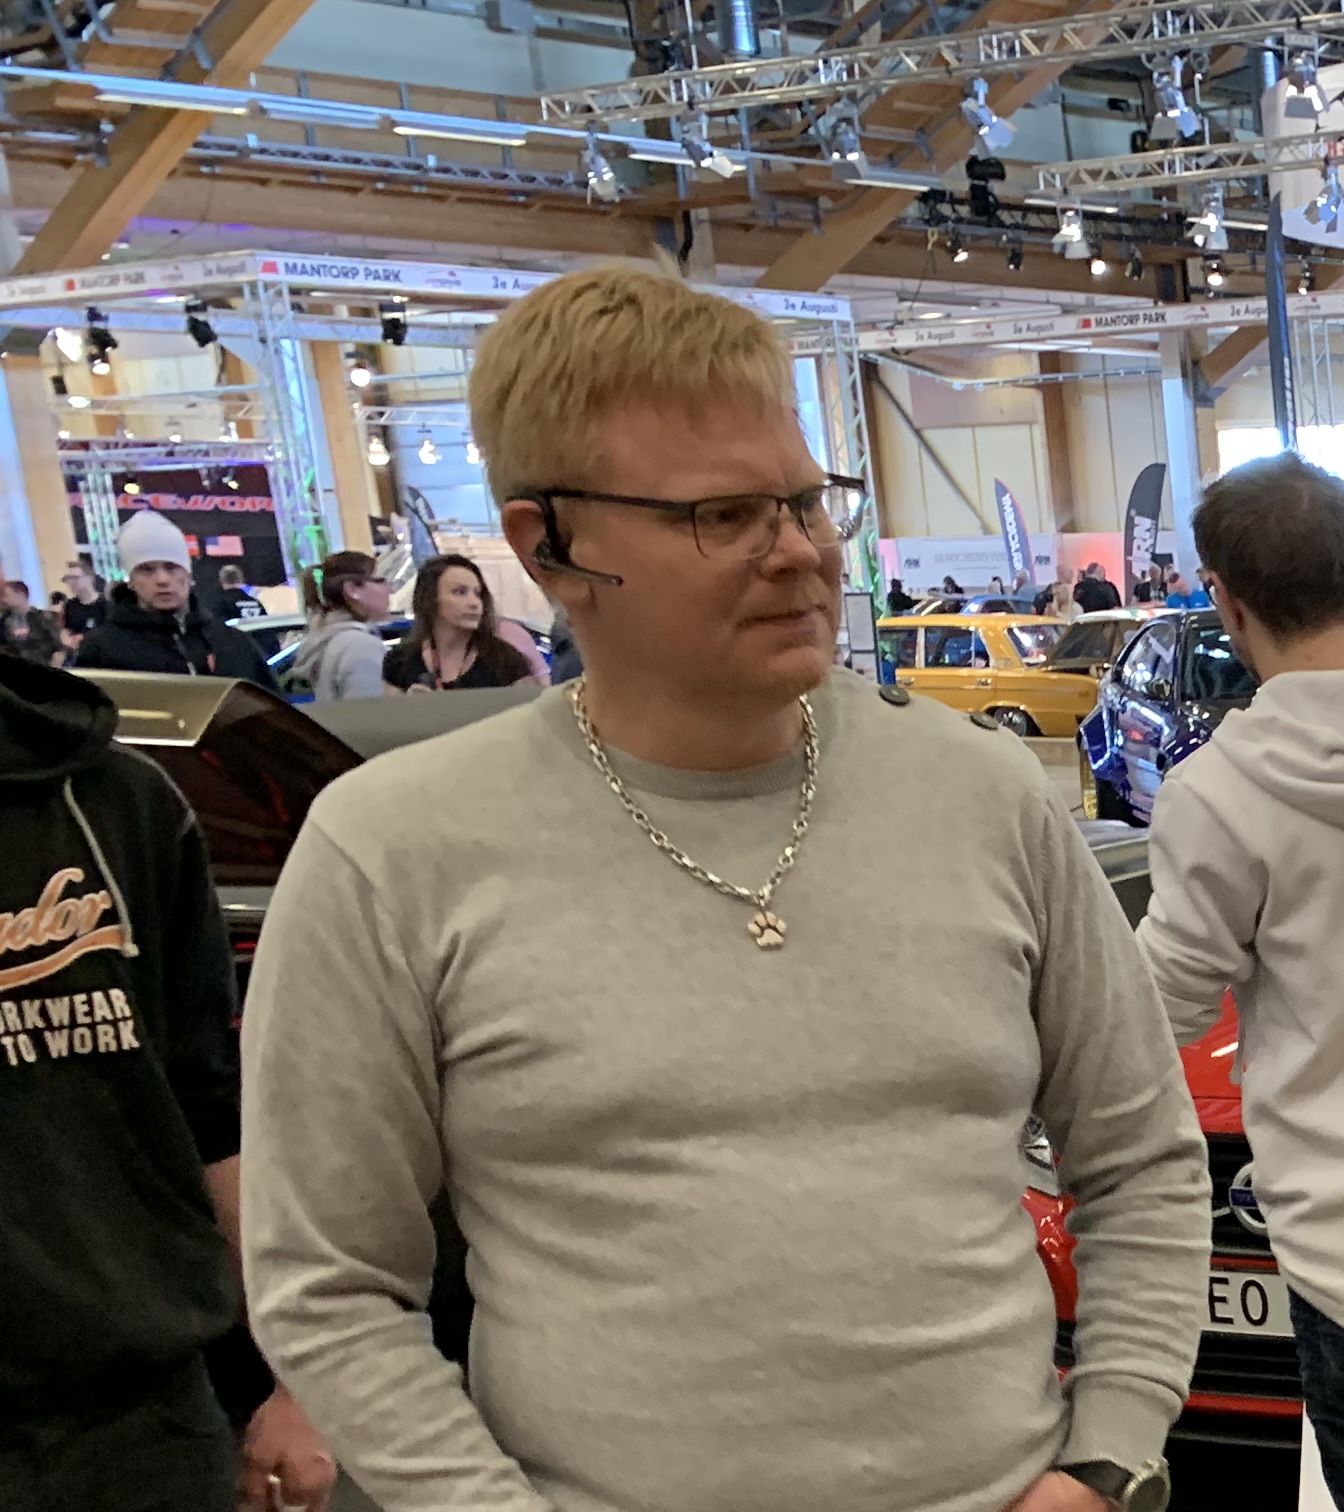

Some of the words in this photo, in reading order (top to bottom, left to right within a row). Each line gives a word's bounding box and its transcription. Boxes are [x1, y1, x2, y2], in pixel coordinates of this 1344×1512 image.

[284, 262, 359, 280] MANTORP
[364, 267, 402, 284] PARK
[1095, 313, 1141, 329] MANTORP
[1143, 311, 1167, 325] PARK
[1230, 304, 1241, 317] 3e
[1244, 303, 1267, 319] Augu
[0, 988, 132, 1035] RKWEAR
[1, 1033, 37, 1066] TO
[44, 1019, 140, 1060] WORK
